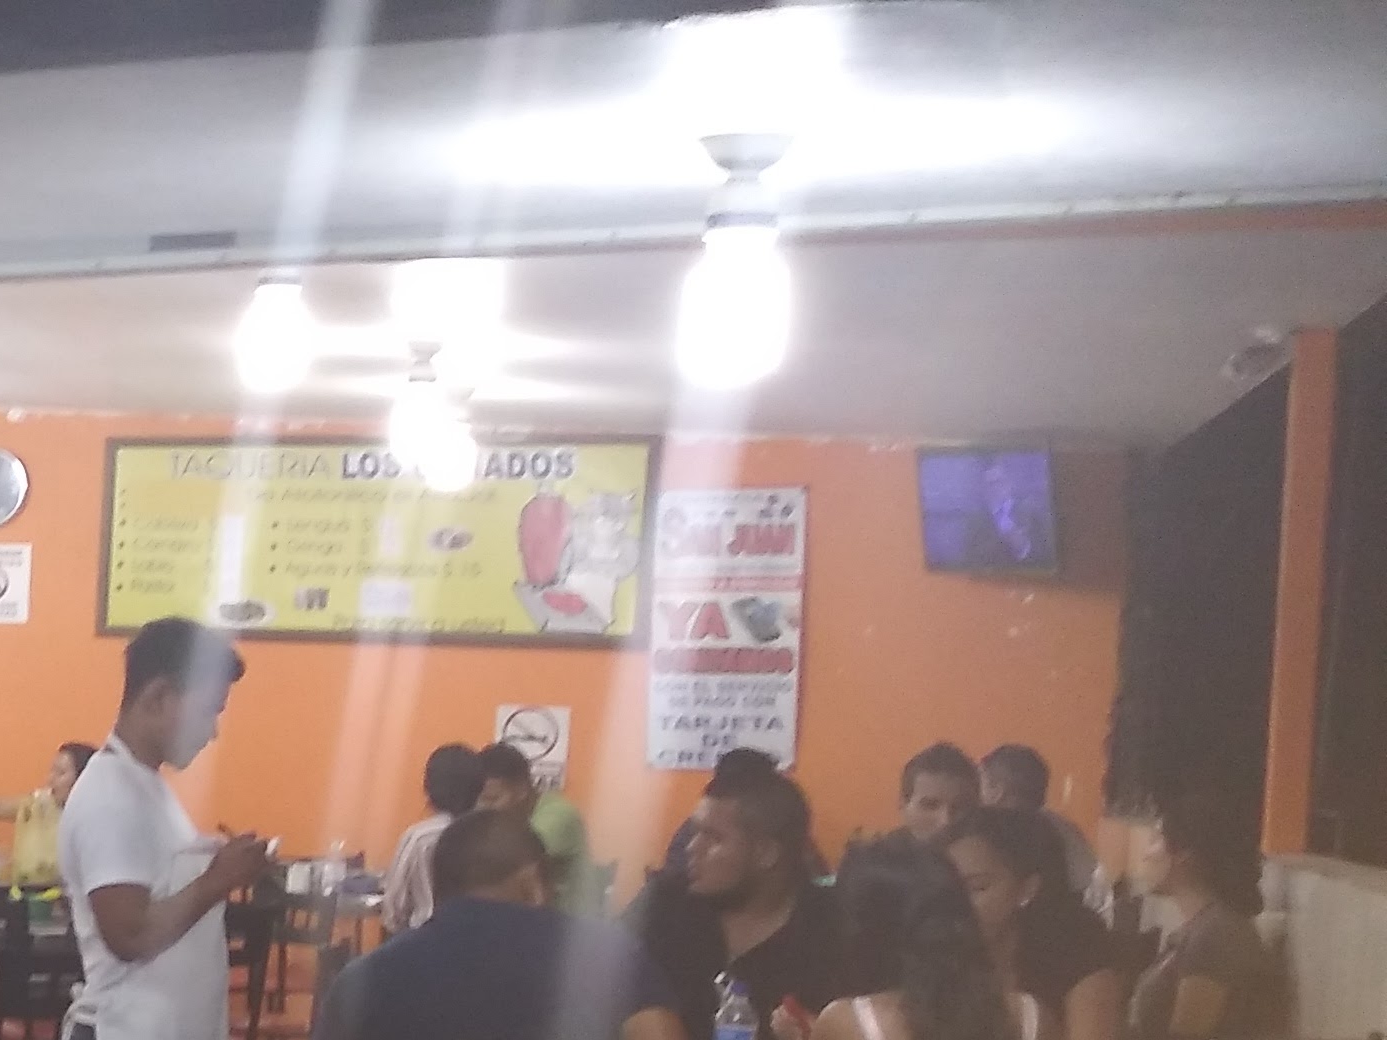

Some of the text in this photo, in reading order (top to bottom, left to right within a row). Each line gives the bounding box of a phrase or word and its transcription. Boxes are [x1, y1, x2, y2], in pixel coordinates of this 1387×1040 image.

[341, 450, 401, 480] LOS
[657, 601, 730, 640] YA
[659, 715, 784, 731] TARJETA
